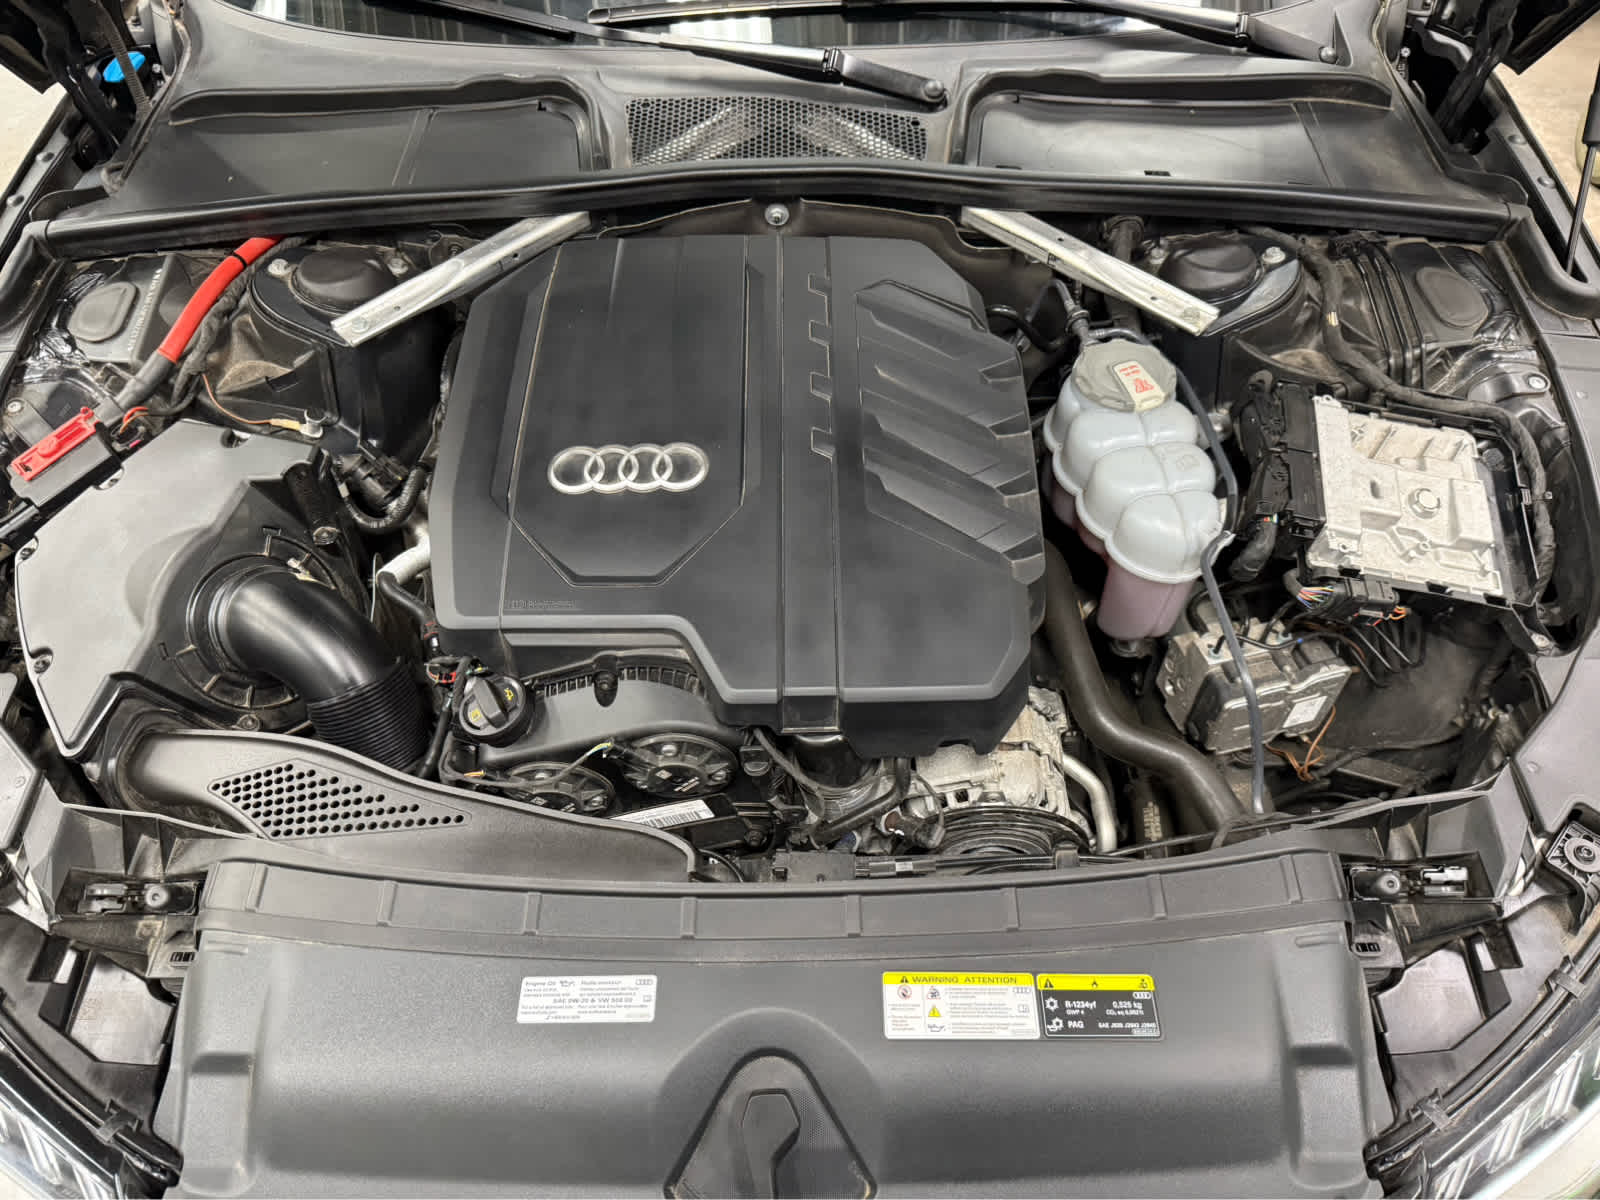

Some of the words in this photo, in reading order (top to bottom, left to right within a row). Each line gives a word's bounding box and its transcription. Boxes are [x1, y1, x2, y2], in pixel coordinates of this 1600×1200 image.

[911, 975, 959, 983] WARNING
[964, 976, 1017, 984] ATTENTION
[1065, 1000, 1097, 1009] R-1234yf
[1133, 1001, 1143, 1009] kg
[1067, 1020, 1084, 1028] PAG
